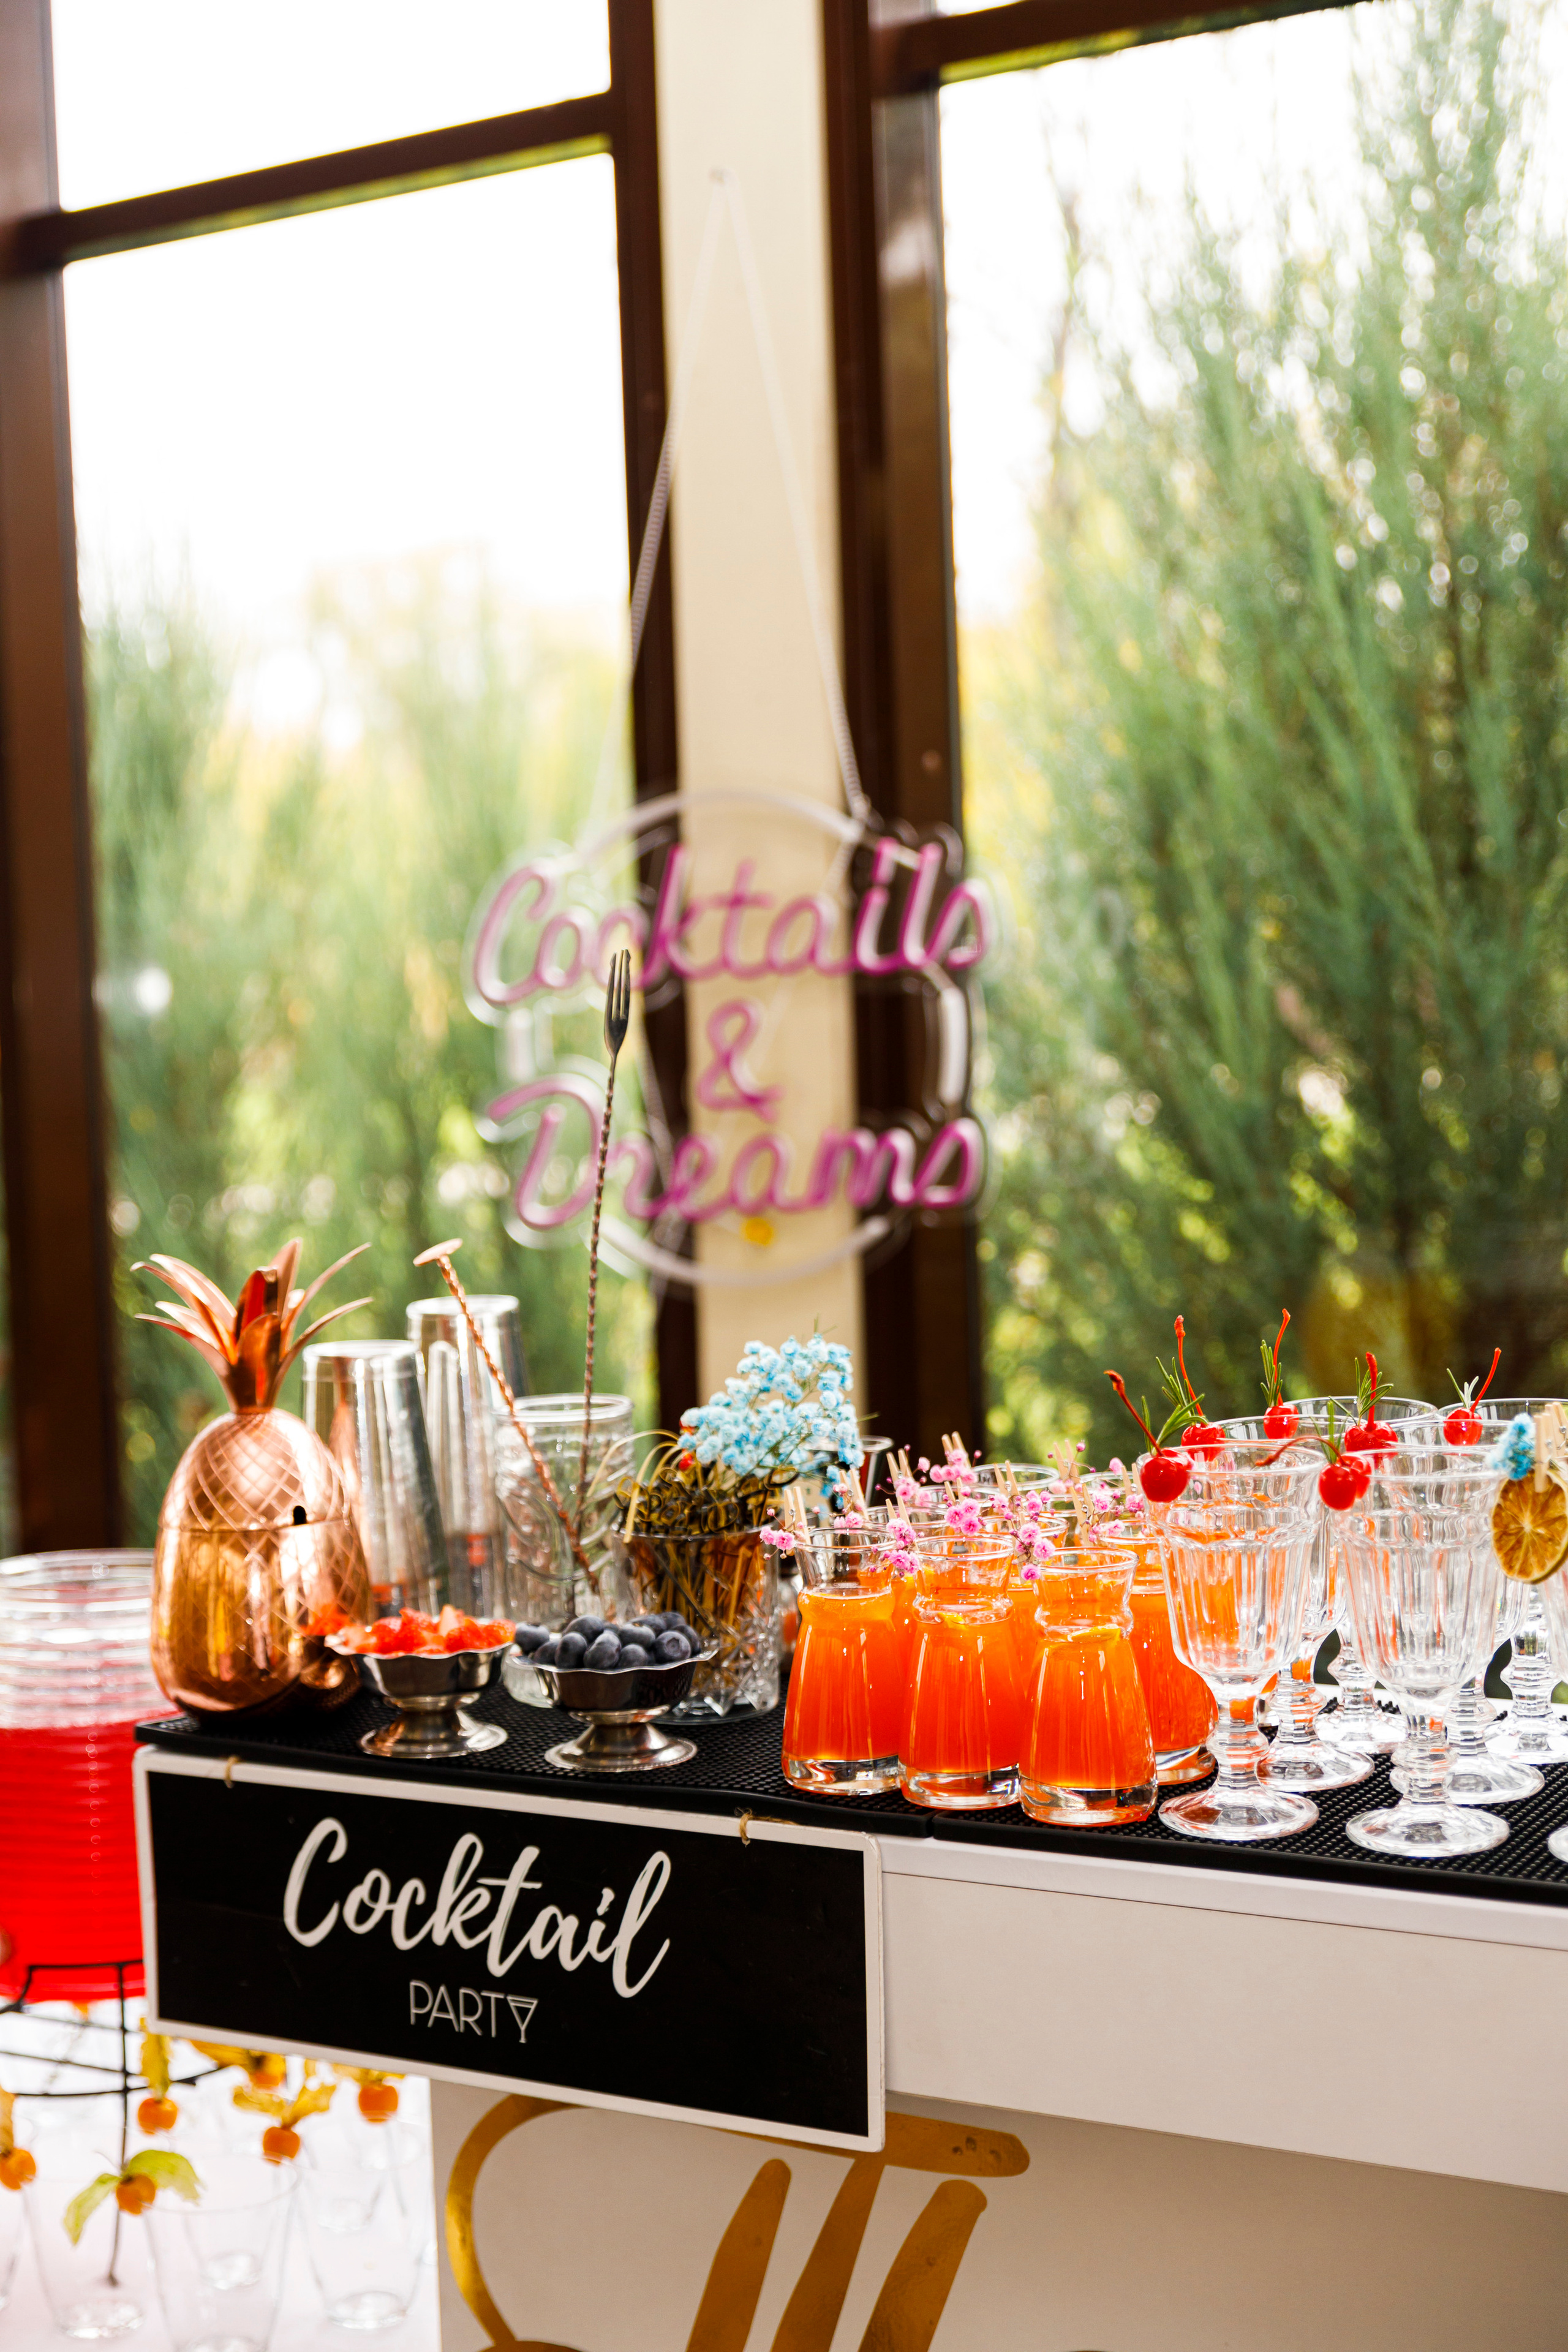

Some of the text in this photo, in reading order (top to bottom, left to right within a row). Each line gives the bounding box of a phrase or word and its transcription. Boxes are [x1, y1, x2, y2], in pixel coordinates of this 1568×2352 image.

[473, 837, 991, 1005] Cocktails
[696, 999, 783, 1123] &
[488, 1074, 985, 1229] Dreams
[282, 1817, 672, 1998] Cocktail
[409, 1979, 538, 2043] PARTY
